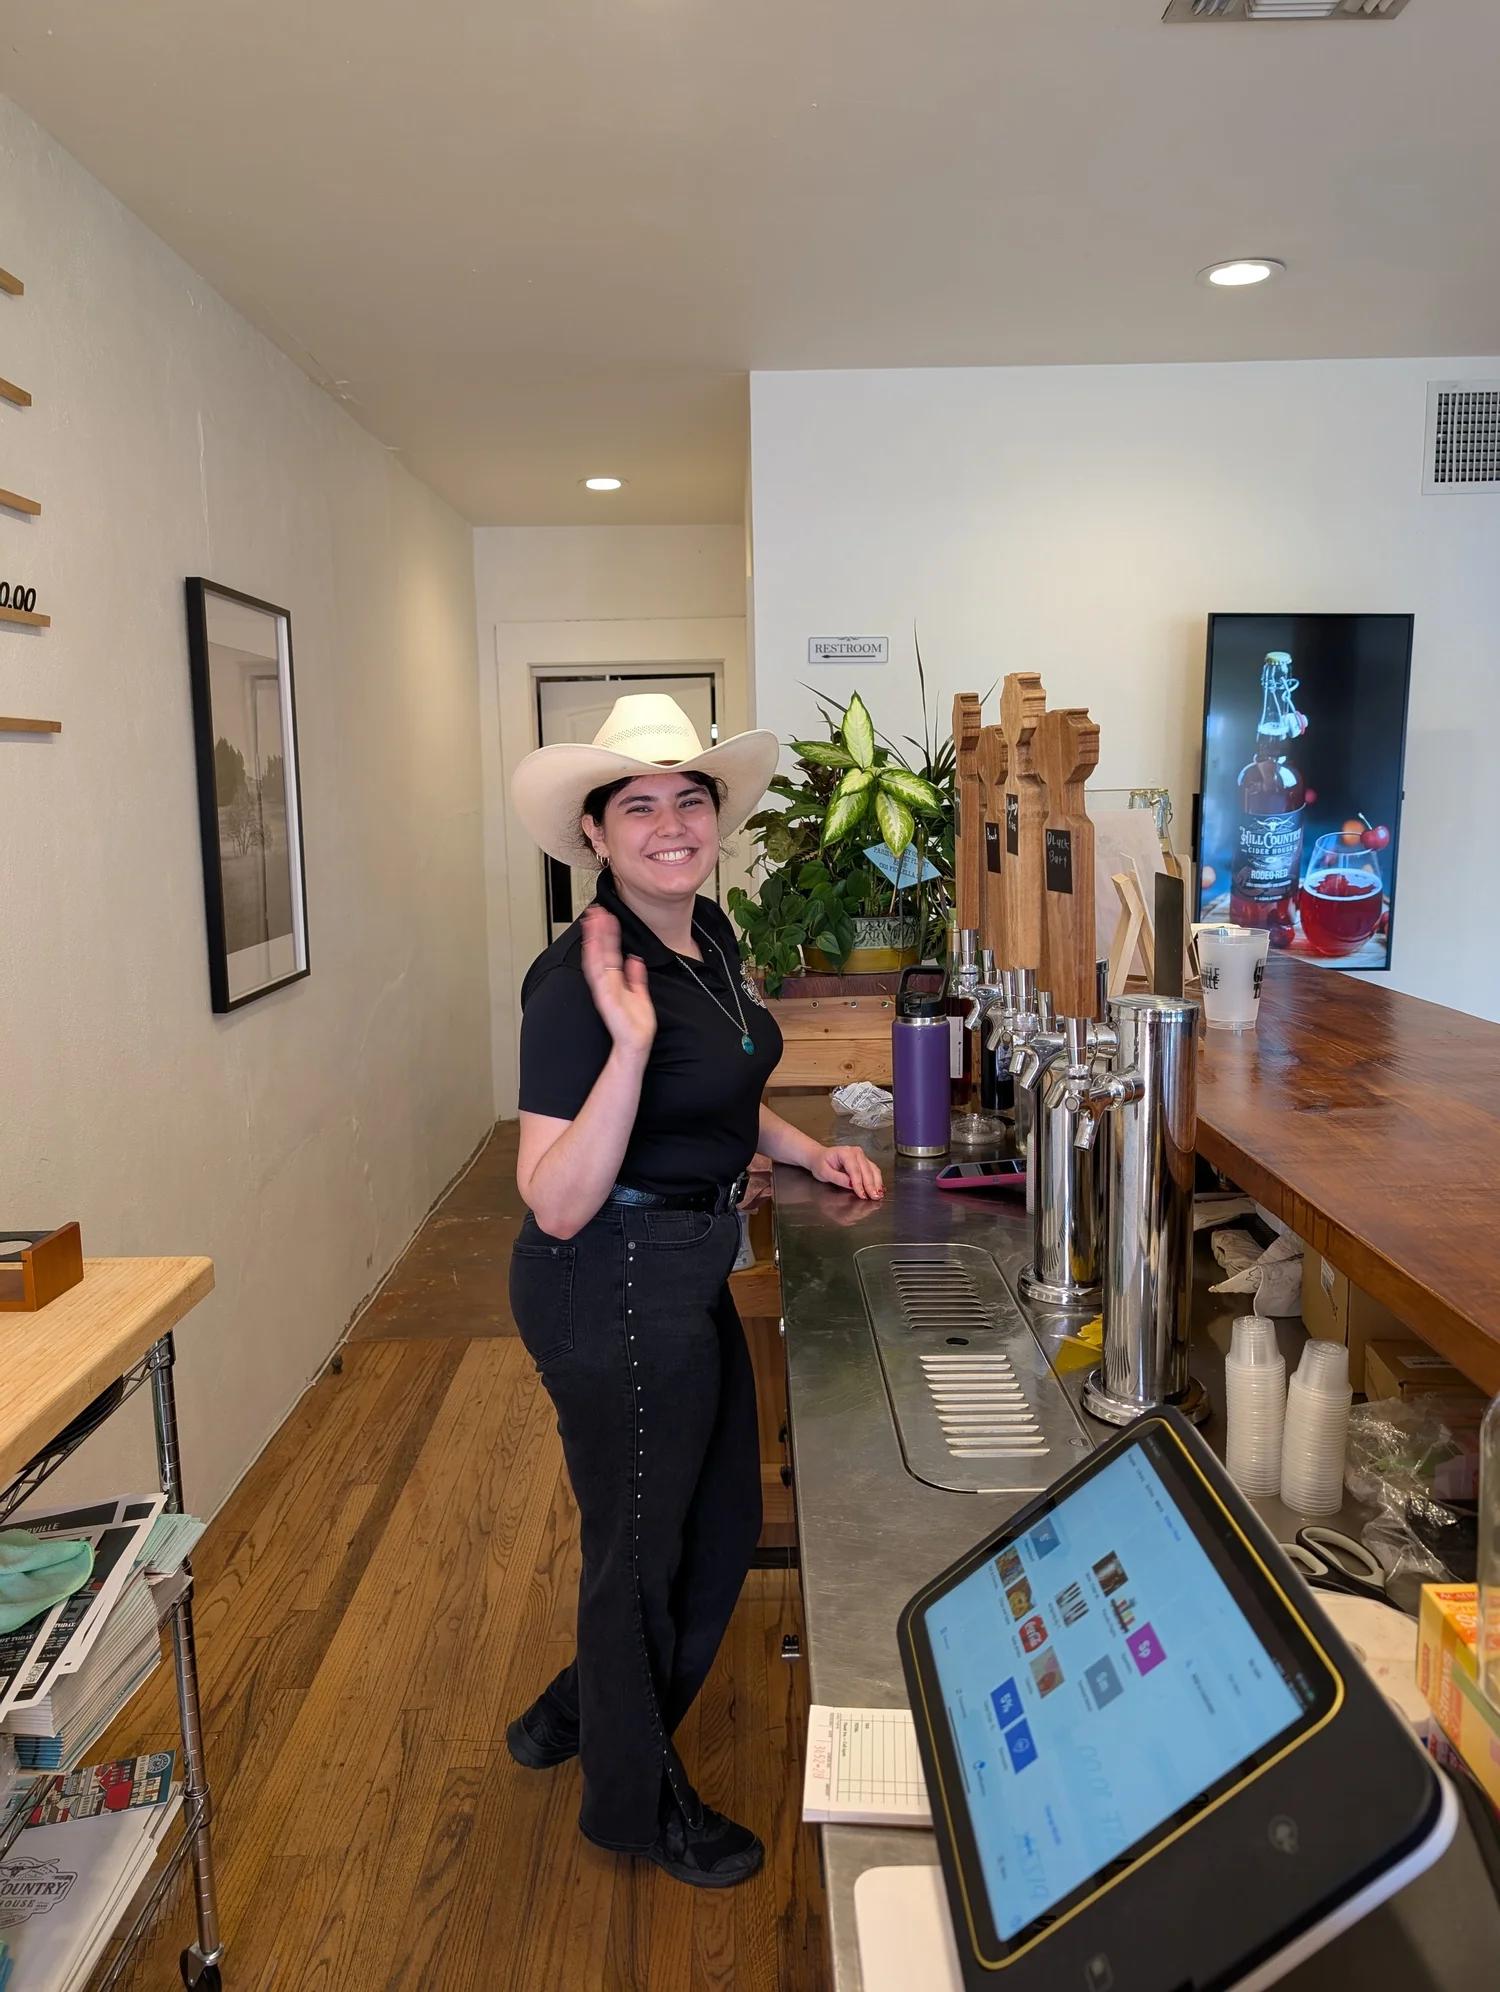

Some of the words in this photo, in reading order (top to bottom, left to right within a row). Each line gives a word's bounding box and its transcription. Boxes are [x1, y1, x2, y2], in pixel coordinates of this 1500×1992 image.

[815, 643, 882, 653] RESTROOM
[1248, 847, 1270, 855] CIDER
[1272, 845, 1293, 854] HOUSE
